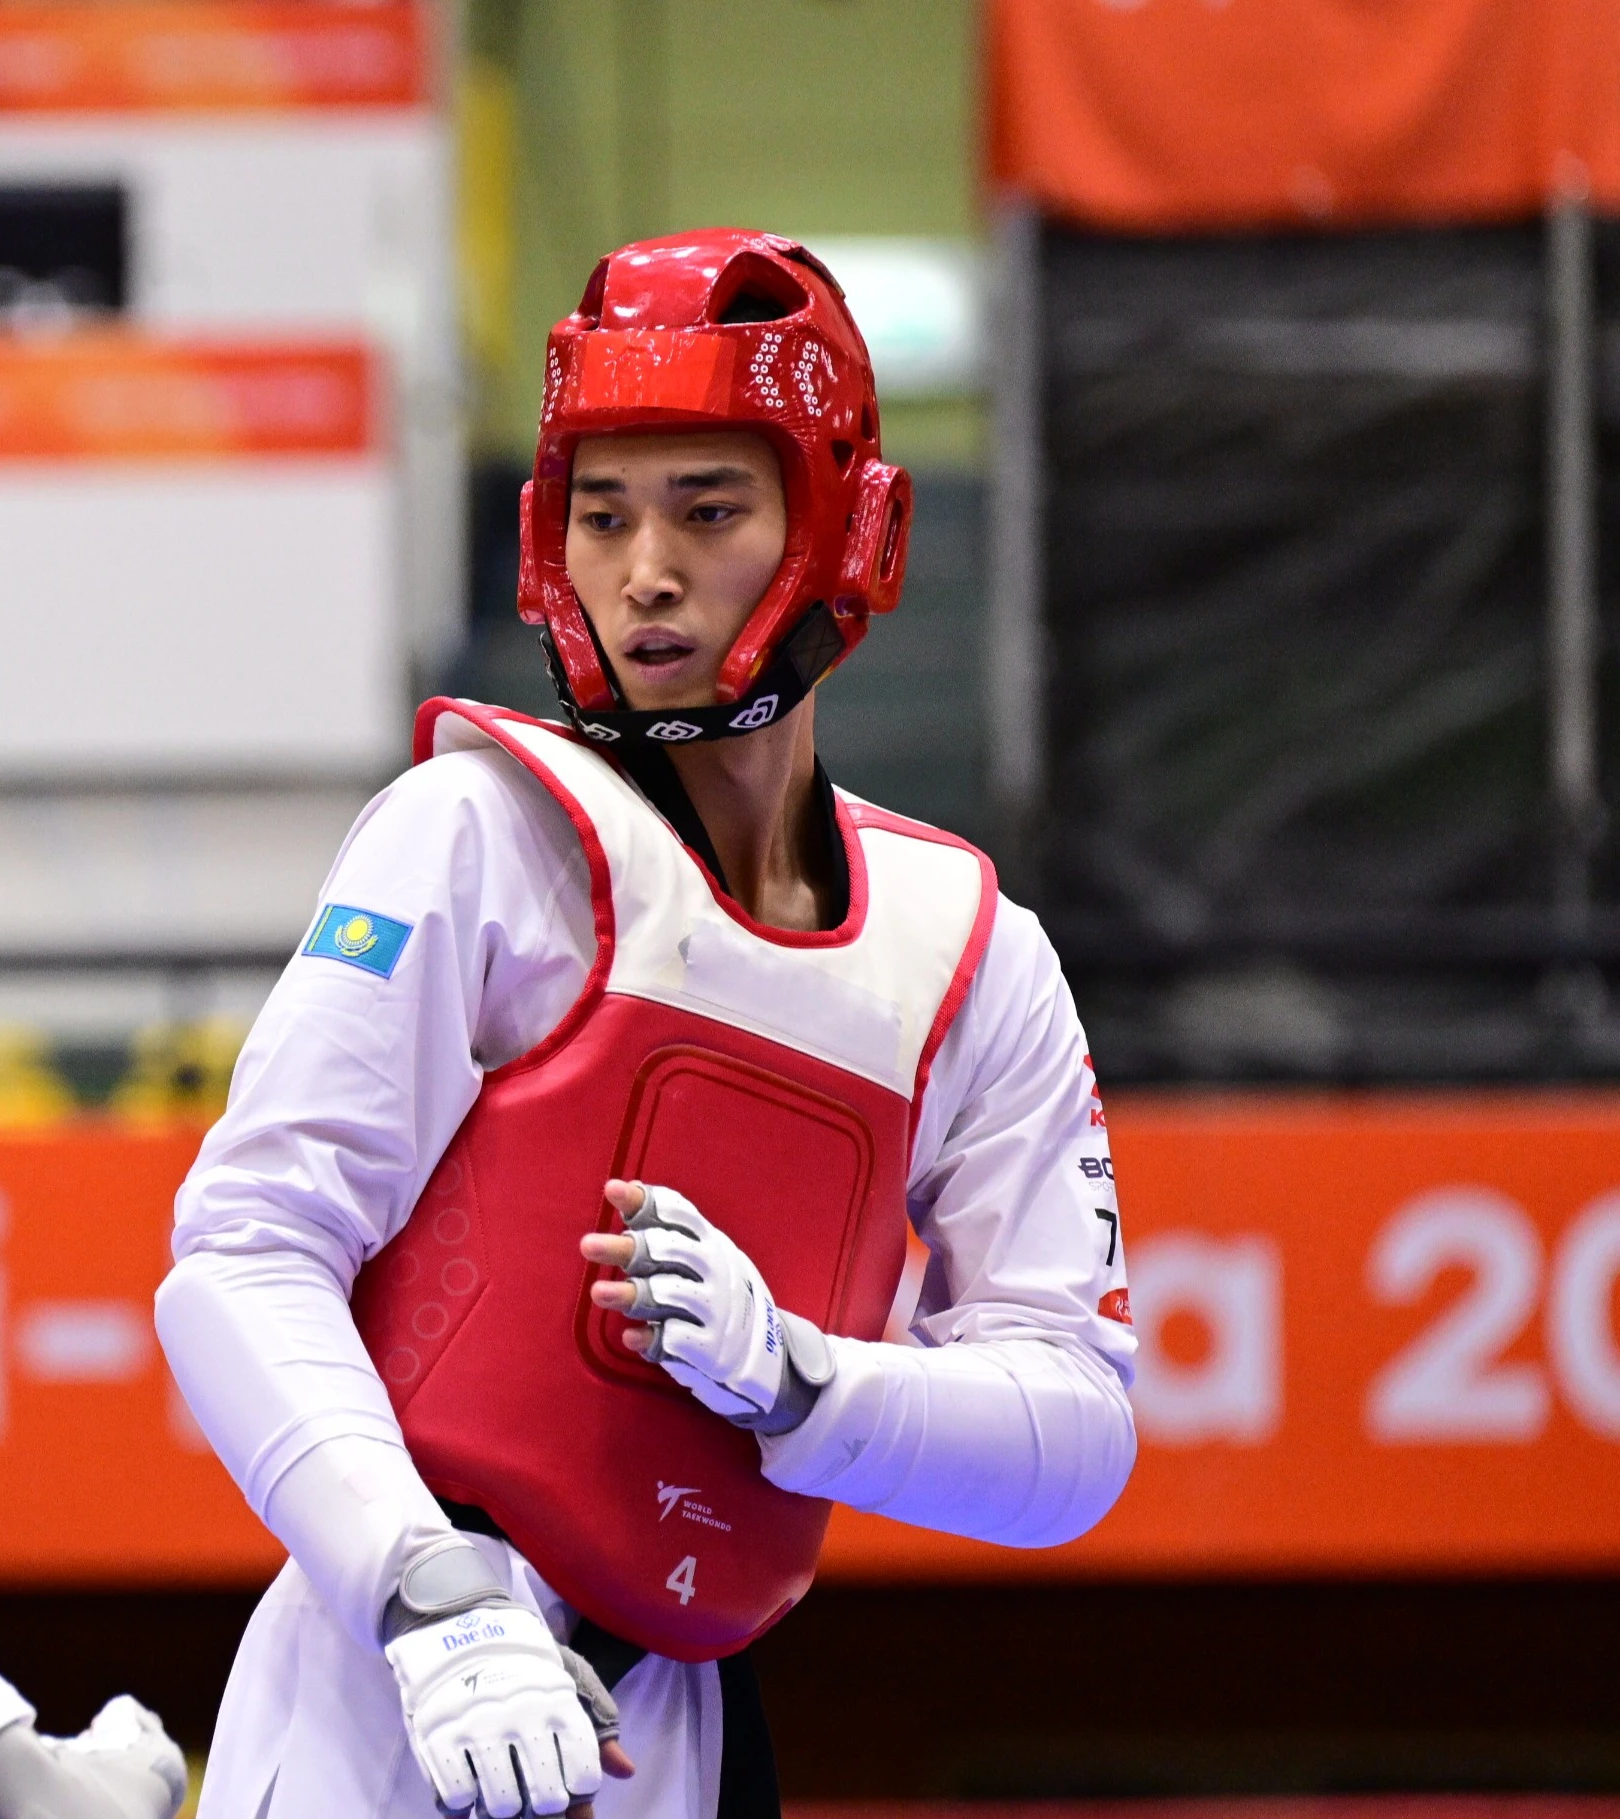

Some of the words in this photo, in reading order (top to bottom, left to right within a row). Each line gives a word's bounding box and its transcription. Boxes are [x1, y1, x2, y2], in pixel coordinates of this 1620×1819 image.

[1094, 1208, 1118, 1266] 7
[682, 1510, 732, 1532] TAEKWONDO
[683, 1500, 713, 1515] WORLD
[665, 1555, 697, 1606] 4
